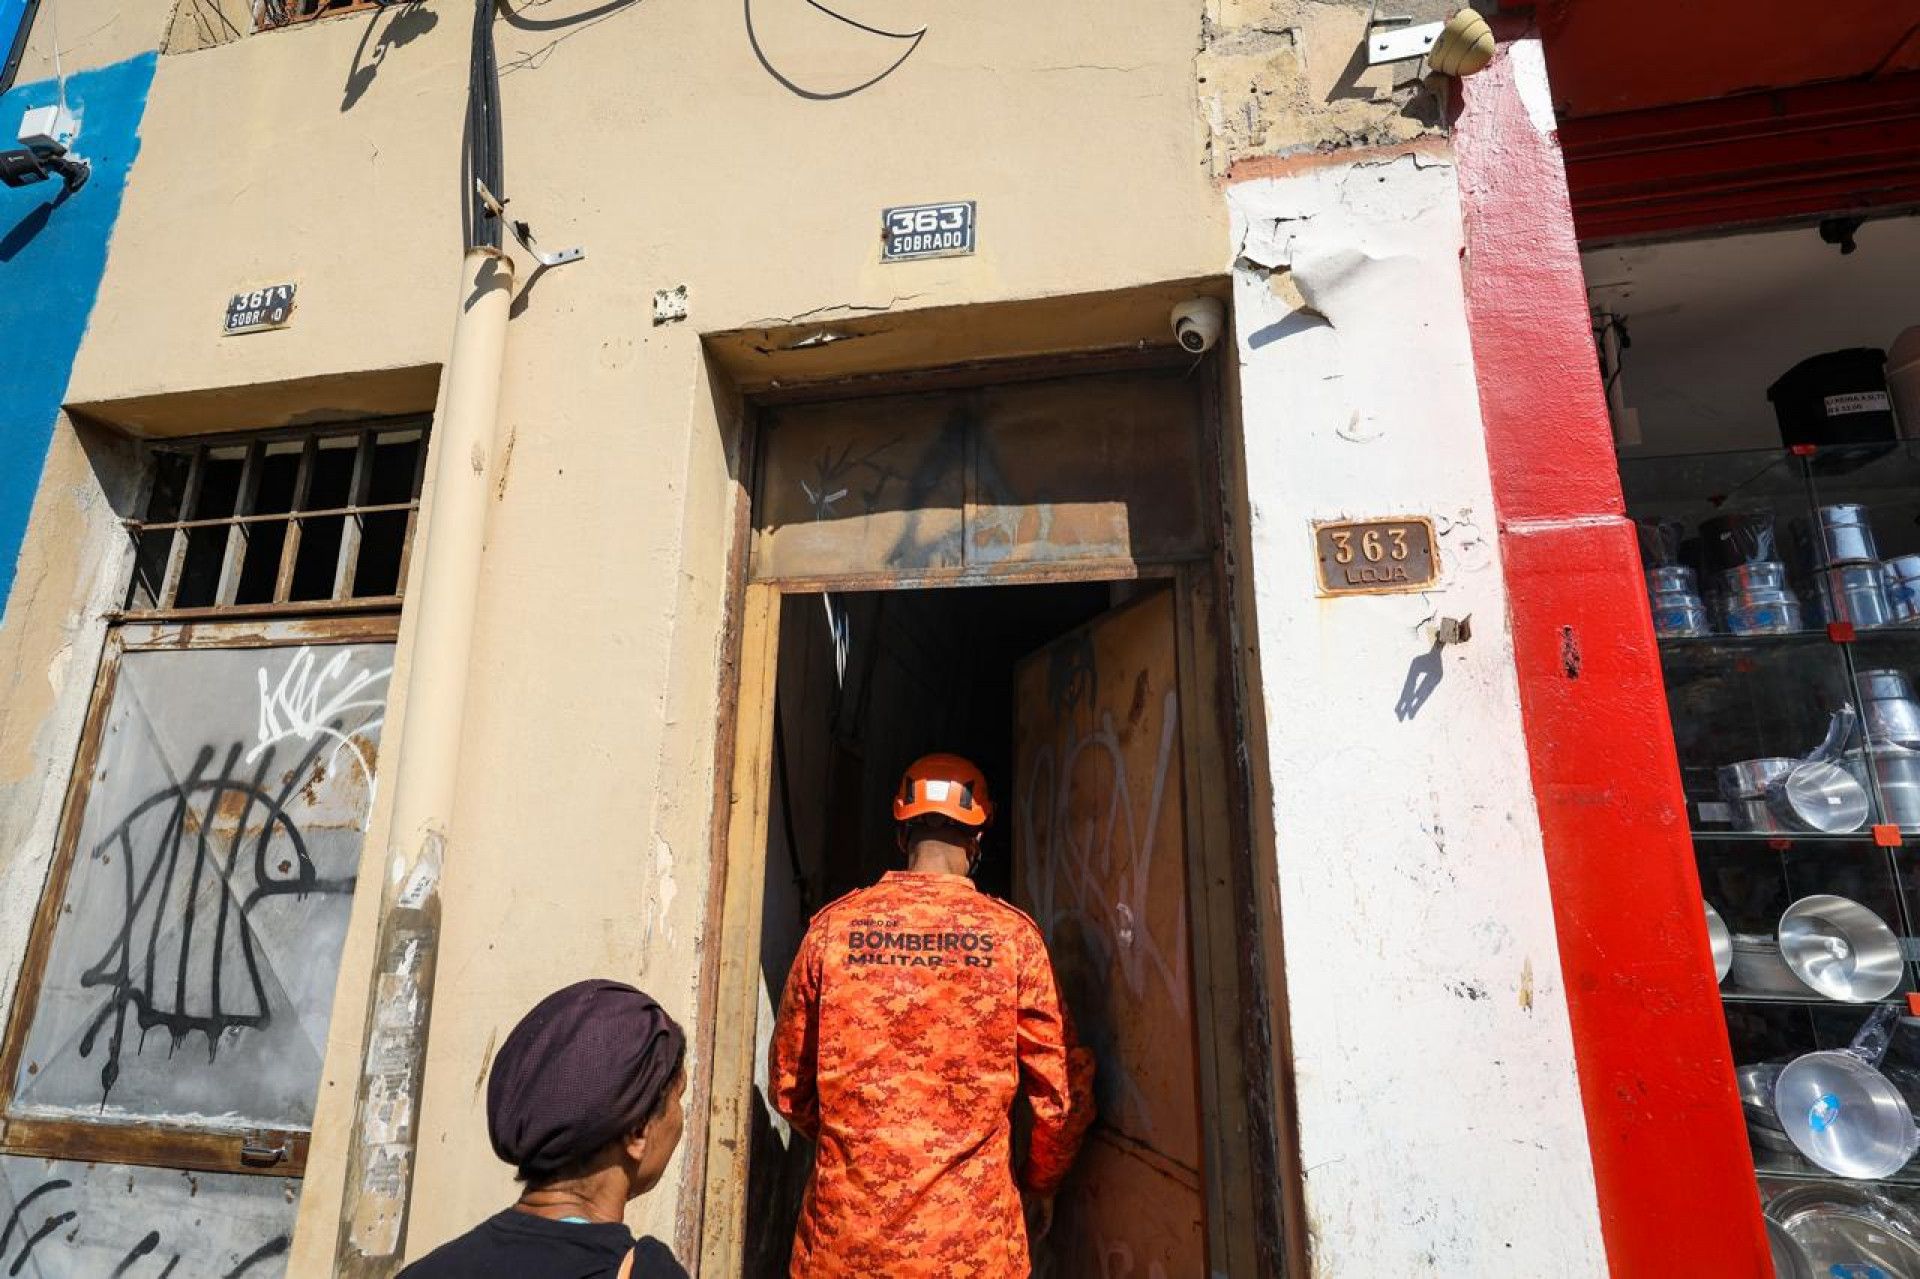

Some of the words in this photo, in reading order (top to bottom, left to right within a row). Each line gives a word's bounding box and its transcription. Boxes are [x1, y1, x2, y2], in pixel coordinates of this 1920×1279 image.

[892, 207, 963, 235] 363
[893, 231, 961, 253] SOBRADO
[230, 307, 283, 327] SOBRO
[1331, 528, 1408, 563] 363
[1345, 565, 1409, 585] LOJA
[848, 931, 994, 951] BOMBEIROS
[848, 953, 942, 967] MILITAR
[964, 955, 993, 968] RJ
